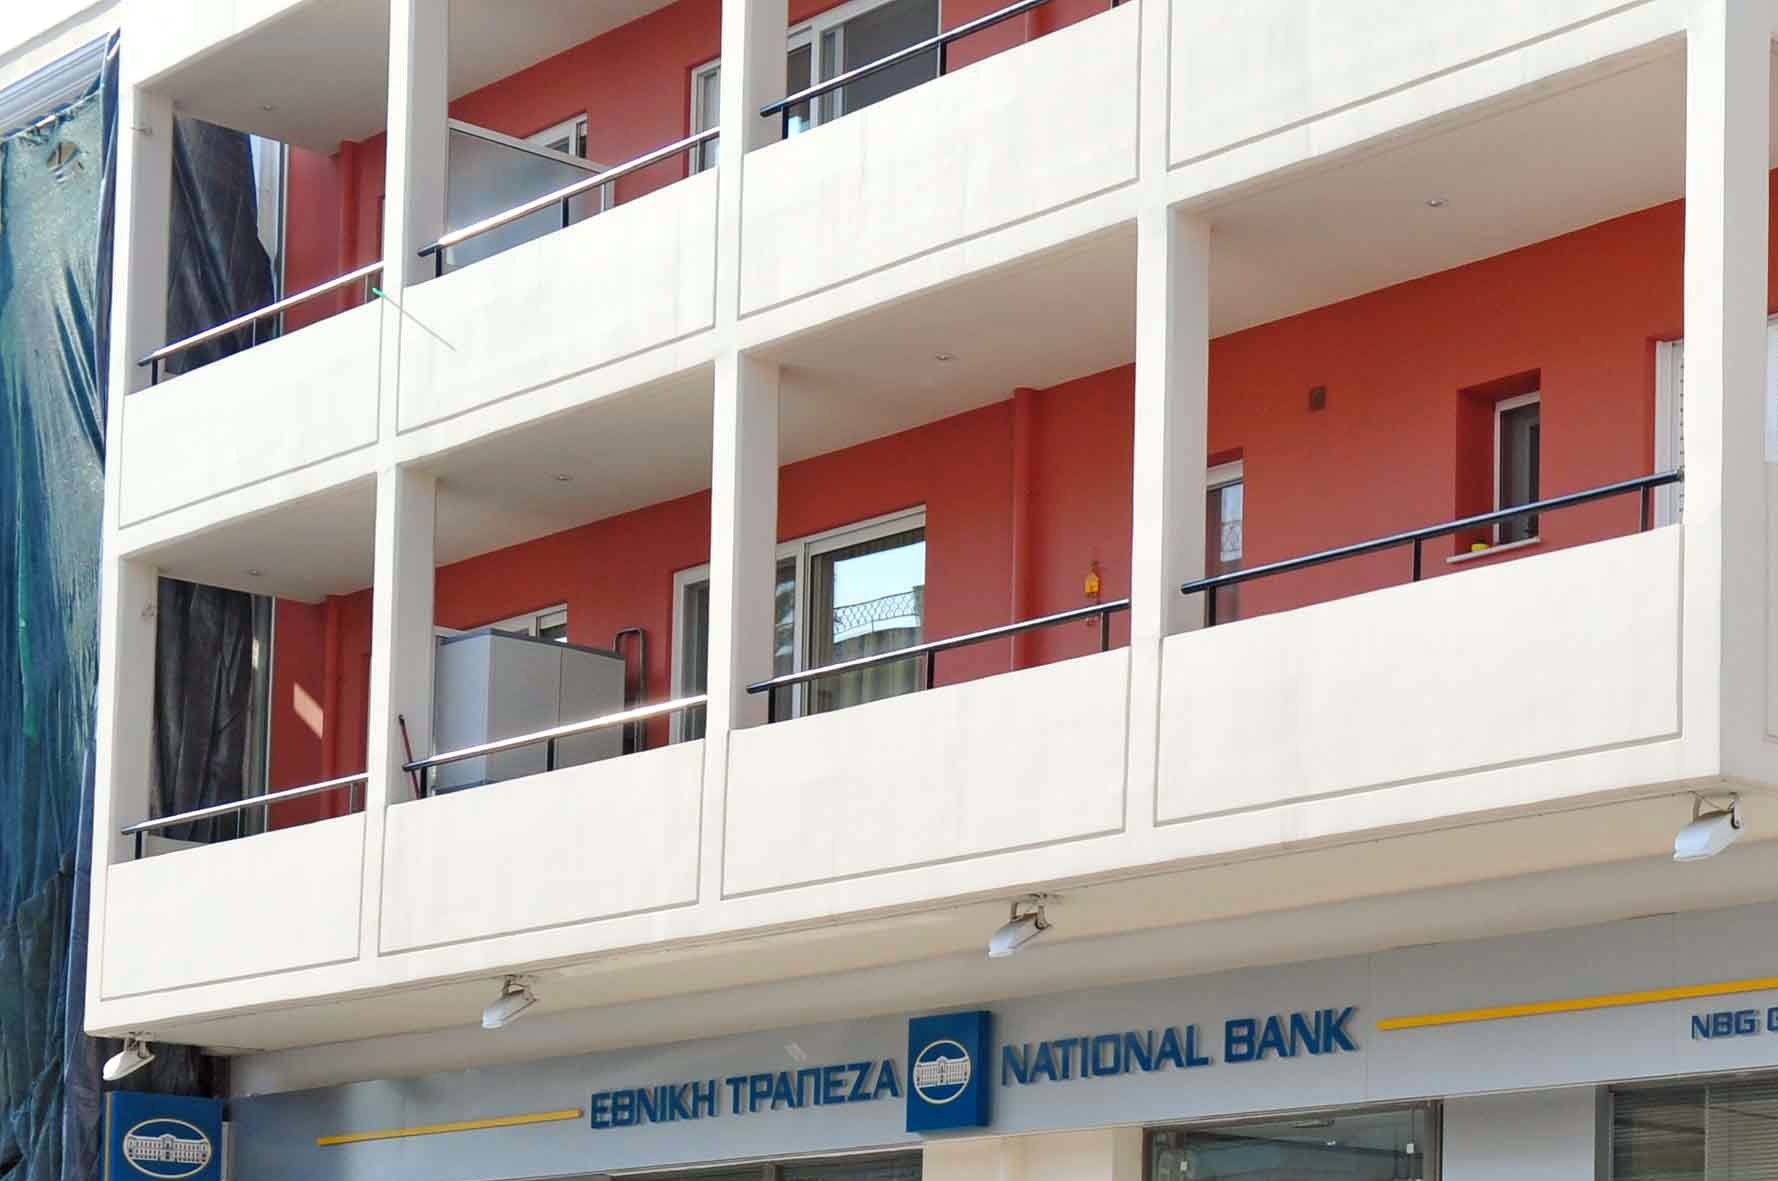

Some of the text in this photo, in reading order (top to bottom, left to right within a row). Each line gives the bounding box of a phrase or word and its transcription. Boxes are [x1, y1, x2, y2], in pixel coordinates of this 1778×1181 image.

[1001, 1006, 1357, 1087] NATIONAL BANK
[1690, 1008, 1757, 1039] NBG
[725, 1058, 901, 1114] ΤΡΑΠΕΖΑ
